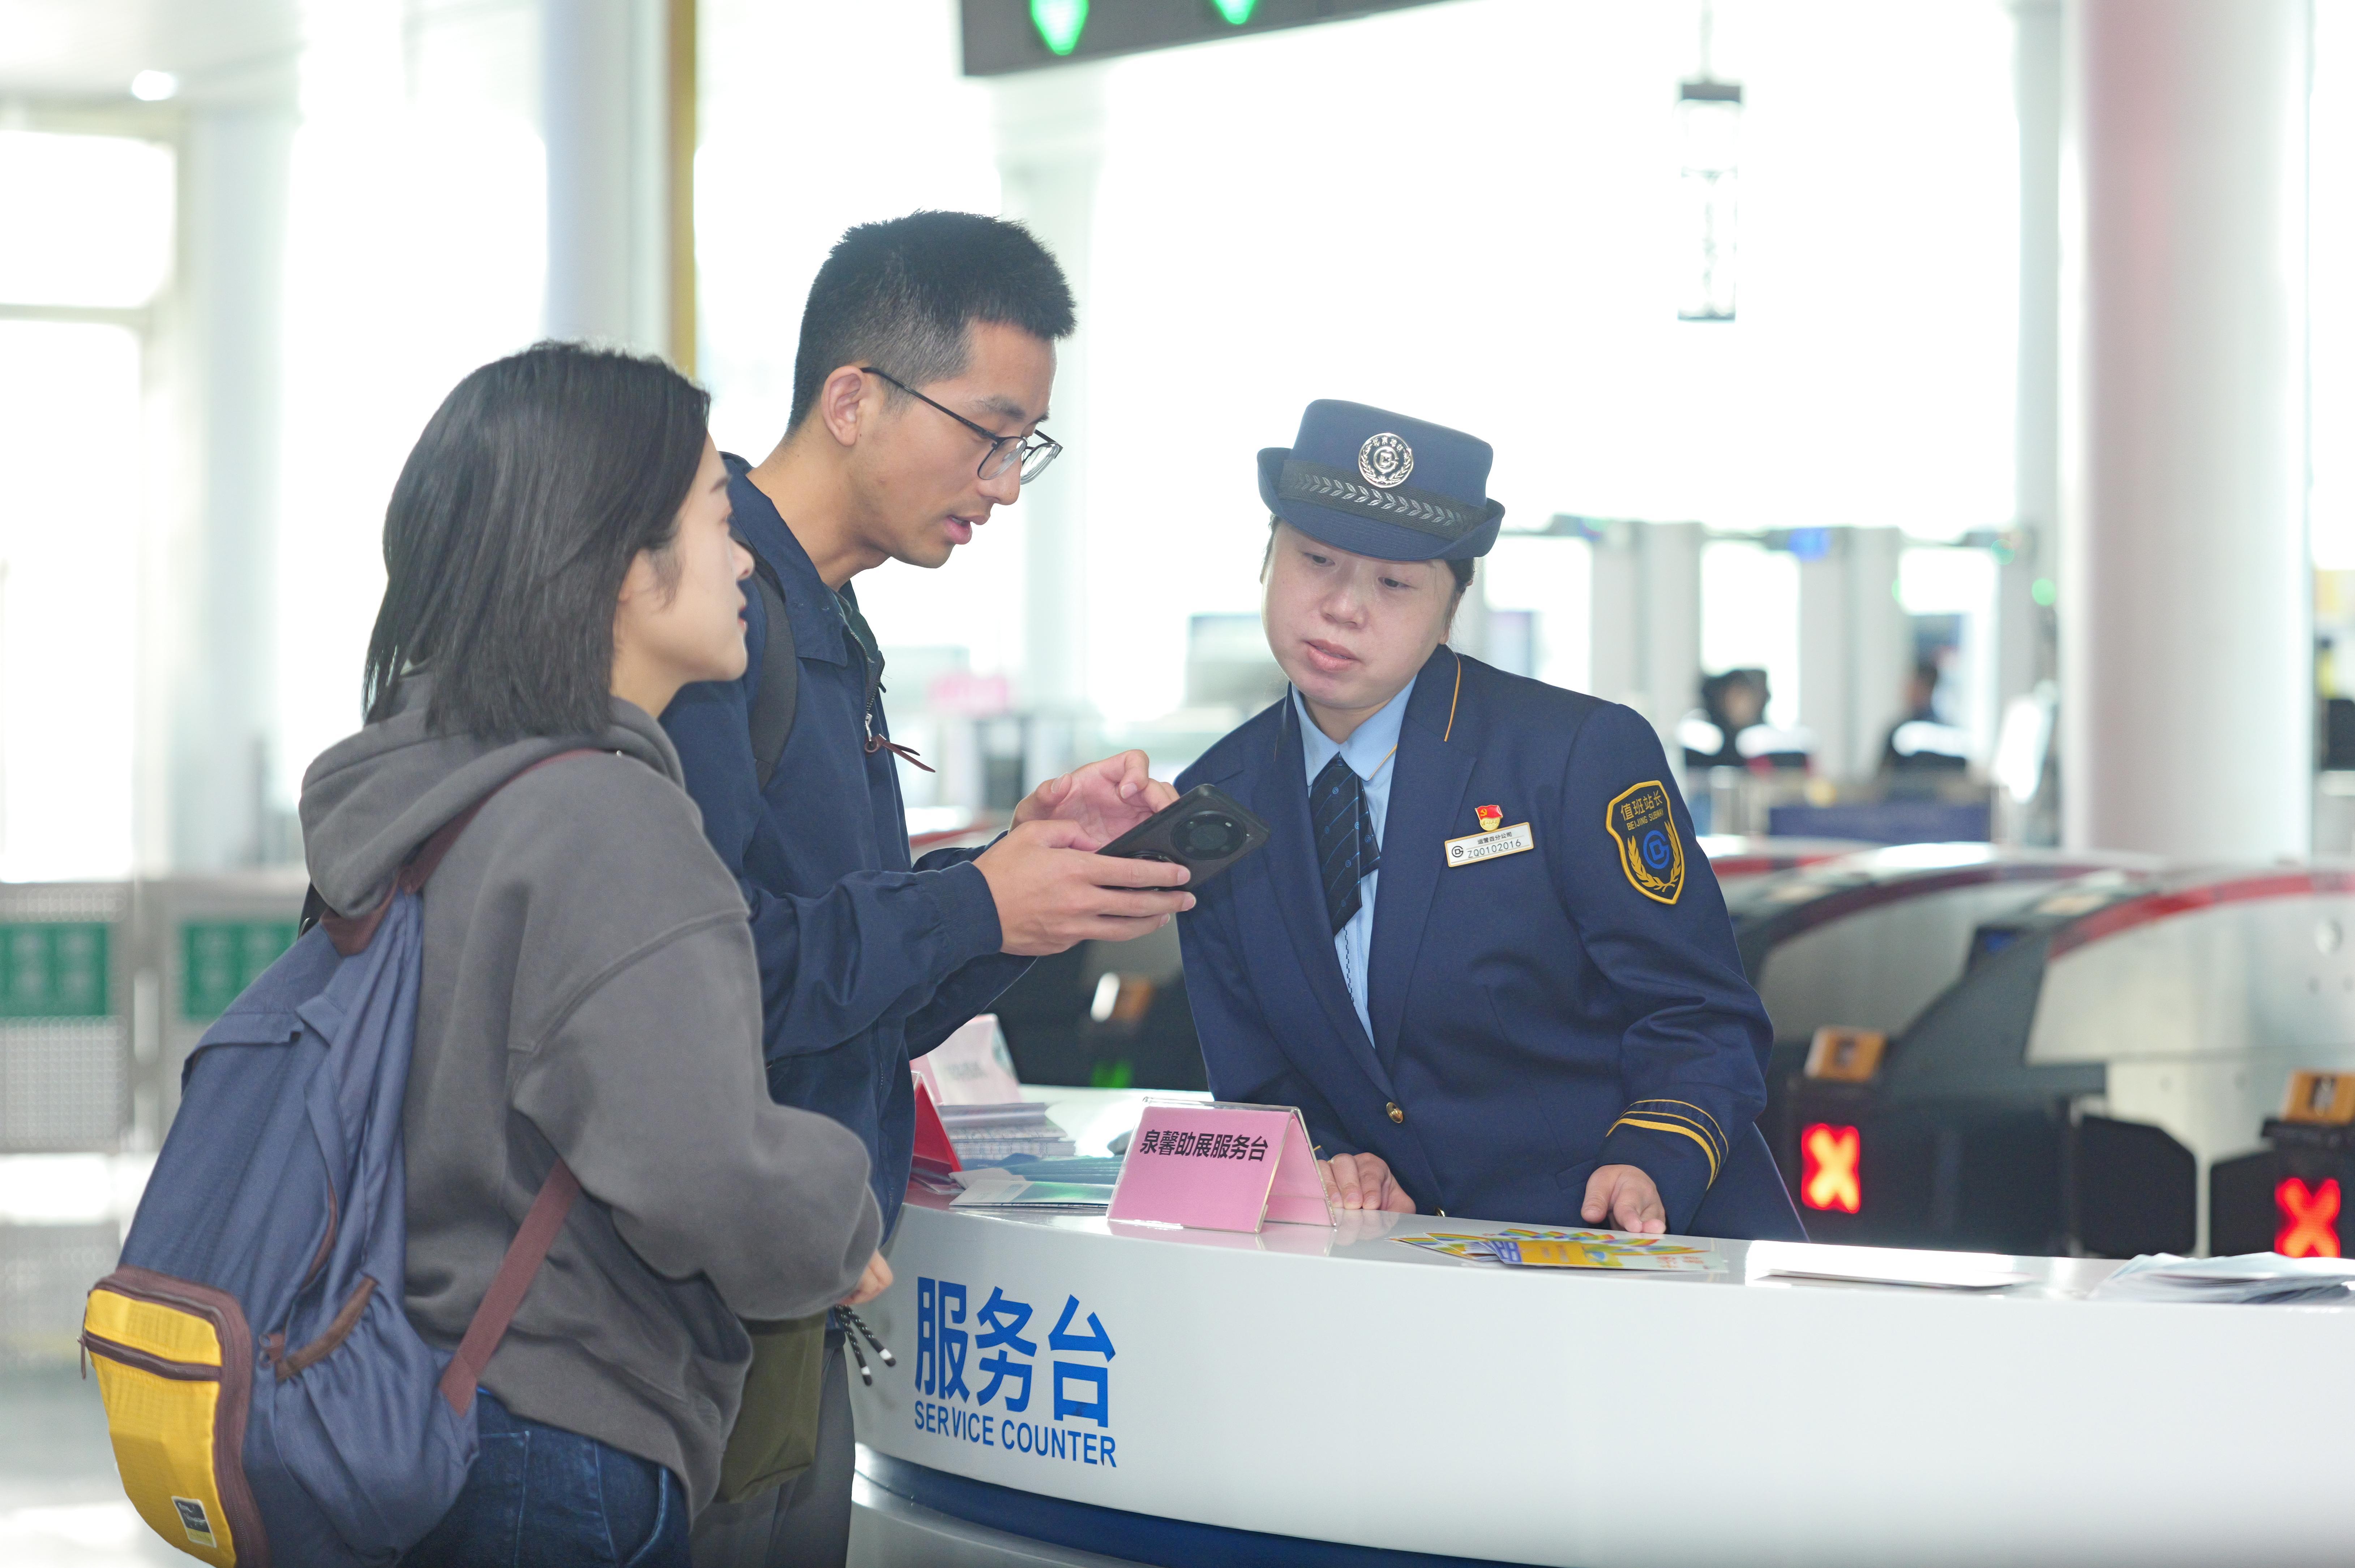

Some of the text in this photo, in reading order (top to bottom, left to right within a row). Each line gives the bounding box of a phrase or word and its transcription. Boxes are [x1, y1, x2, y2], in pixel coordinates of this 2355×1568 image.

[1621, 790, 1662, 821] 值班站长
[1627, 808, 1664, 830] BEIJING SUBWAY
[1468, 839, 1521, 858] ZQ0102016
[1477, 832, 1512, 844] 运营四分公司
[1140, 1129, 1268, 1161] 泉馨助展服务台
[915, 1276, 1116, 1428] 服务台
[915, 1401, 1117, 1467] SERVICE COUNTER
